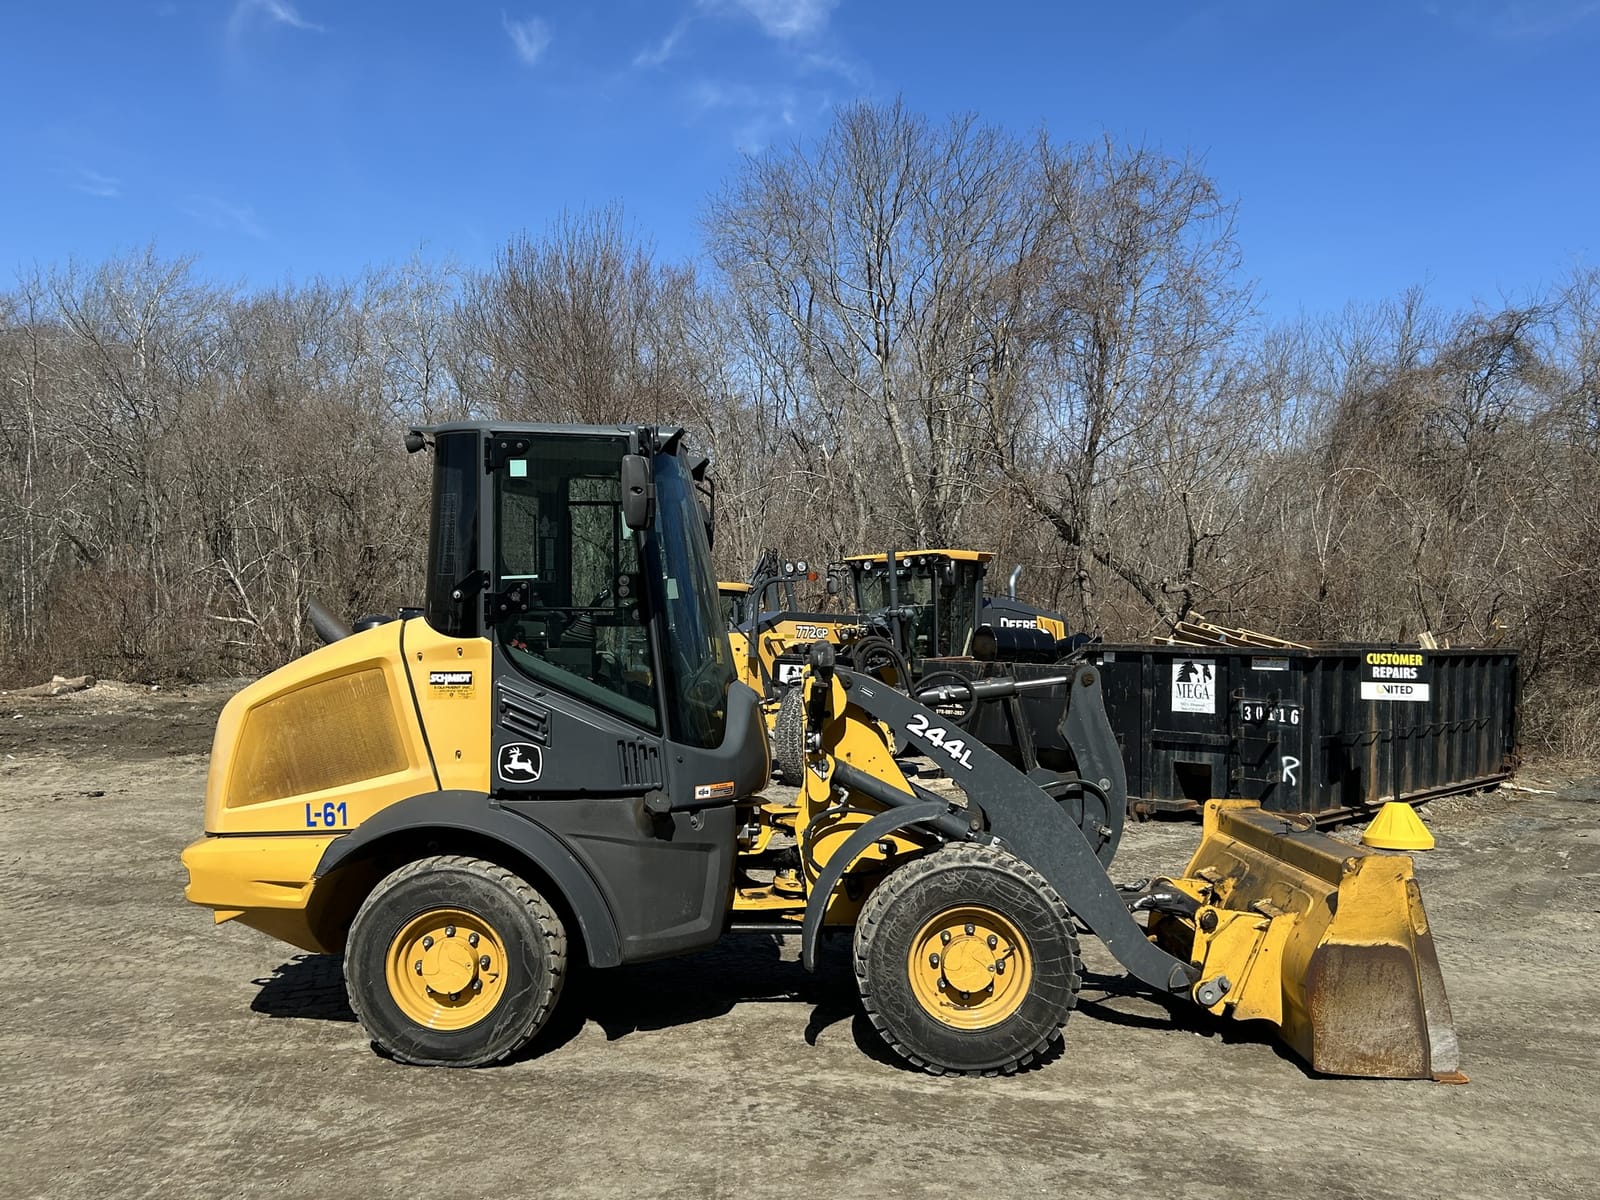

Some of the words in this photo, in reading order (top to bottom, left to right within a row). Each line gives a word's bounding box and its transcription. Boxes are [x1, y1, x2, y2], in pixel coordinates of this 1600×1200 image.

[796, 625, 829, 639] 772GP
[1366, 652, 1424, 666] CUSTOMER
[430, 673, 472, 685] SCHMIDT
[1372, 666, 1418, 679] REPAIRS
[1175, 683, 1210, 700] MEGA
[1375, 683, 1414, 695] UNITED
[906, 714, 974, 770] 244L
[1281, 756, 1301, 787] R
[305, 801, 348, 828] L-61
